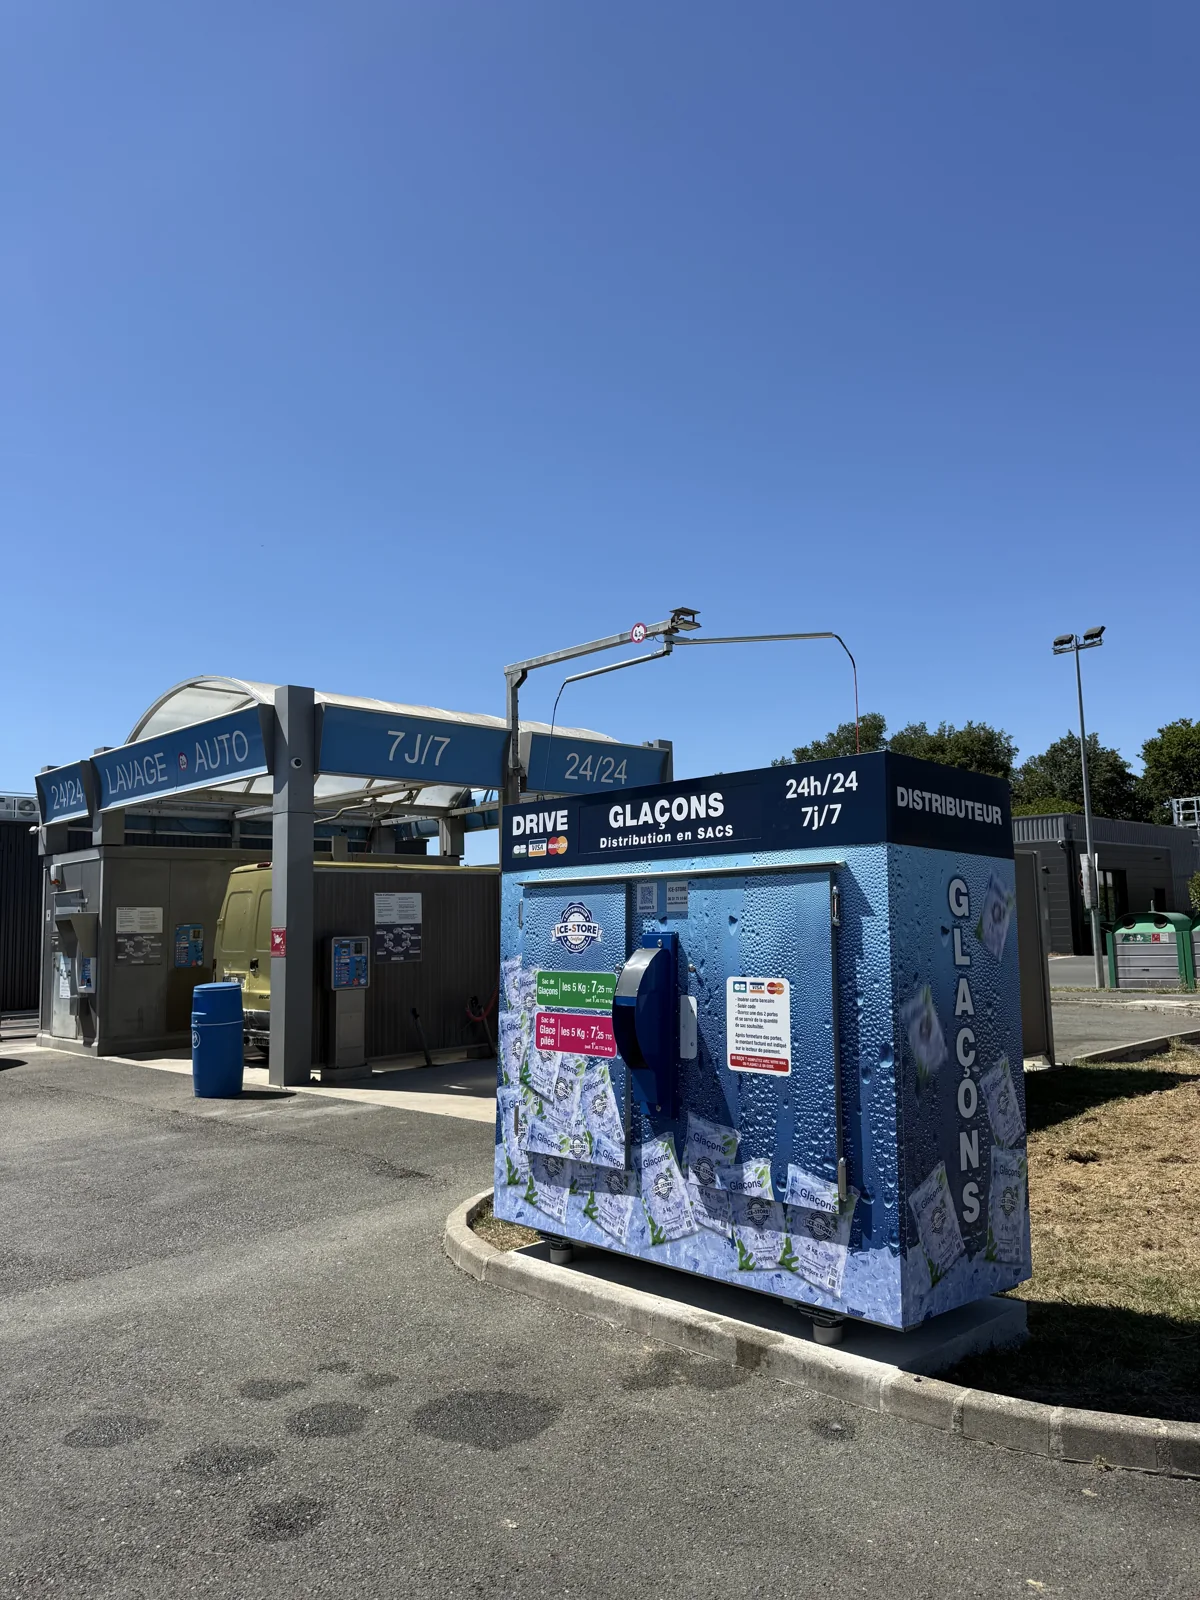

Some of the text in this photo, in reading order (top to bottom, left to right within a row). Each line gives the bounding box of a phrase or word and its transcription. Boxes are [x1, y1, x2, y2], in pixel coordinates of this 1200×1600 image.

[105, 730, 249, 795] LAVAGE AUTO
[564, 752, 628, 785] 24/24
[51, 778, 83, 810] 24/24
[785, 770, 859, 799] 24h/24
[608, 792, 725, 830] GLAÇONS
[801, 803, 842, 830] 7j/7
[896, 786, 1003, 825] DISTRIBUTEUR
[512, 809, 569, 836] DRIVE
[600, 824, 734, 849] Distribution en SACS
[531, 844, 544, 852] VISA
[556, 923, 597, 935] ICE-STORE
[538, 986, 558, 996] Glaçons
[562, 982, 571, 992] les
[572, 983, 577, 992] 5
[578, 983, 587, 994] Kg
[539, 1024, 556, 1035] Glace
[561, 1026, 570, 1036] les
[571, 1027, 576, 1037] 5
[577, 1028, 585, 1040] Kg
[540, 1036, 555, 1047] pilée
[948, 878, 980, 1224] GLAÇONS
[583, 1078, 605, 1092] Glaçons
[537, 1132, 563, 1152] Glaçons
[693, 1132, 727, 1155] Glaçons
[602, 1149, 626, 1171] Glaçon
[643, 1152, 670, 1169] Glaçons
[999, 1164, 1021, 1178] Glaçons
[729, 1179, 763, 1192] Glaçons
[800, 1188, 837, 1213] Glaçons
[921, 1184, 943, 1210] Glaçons
